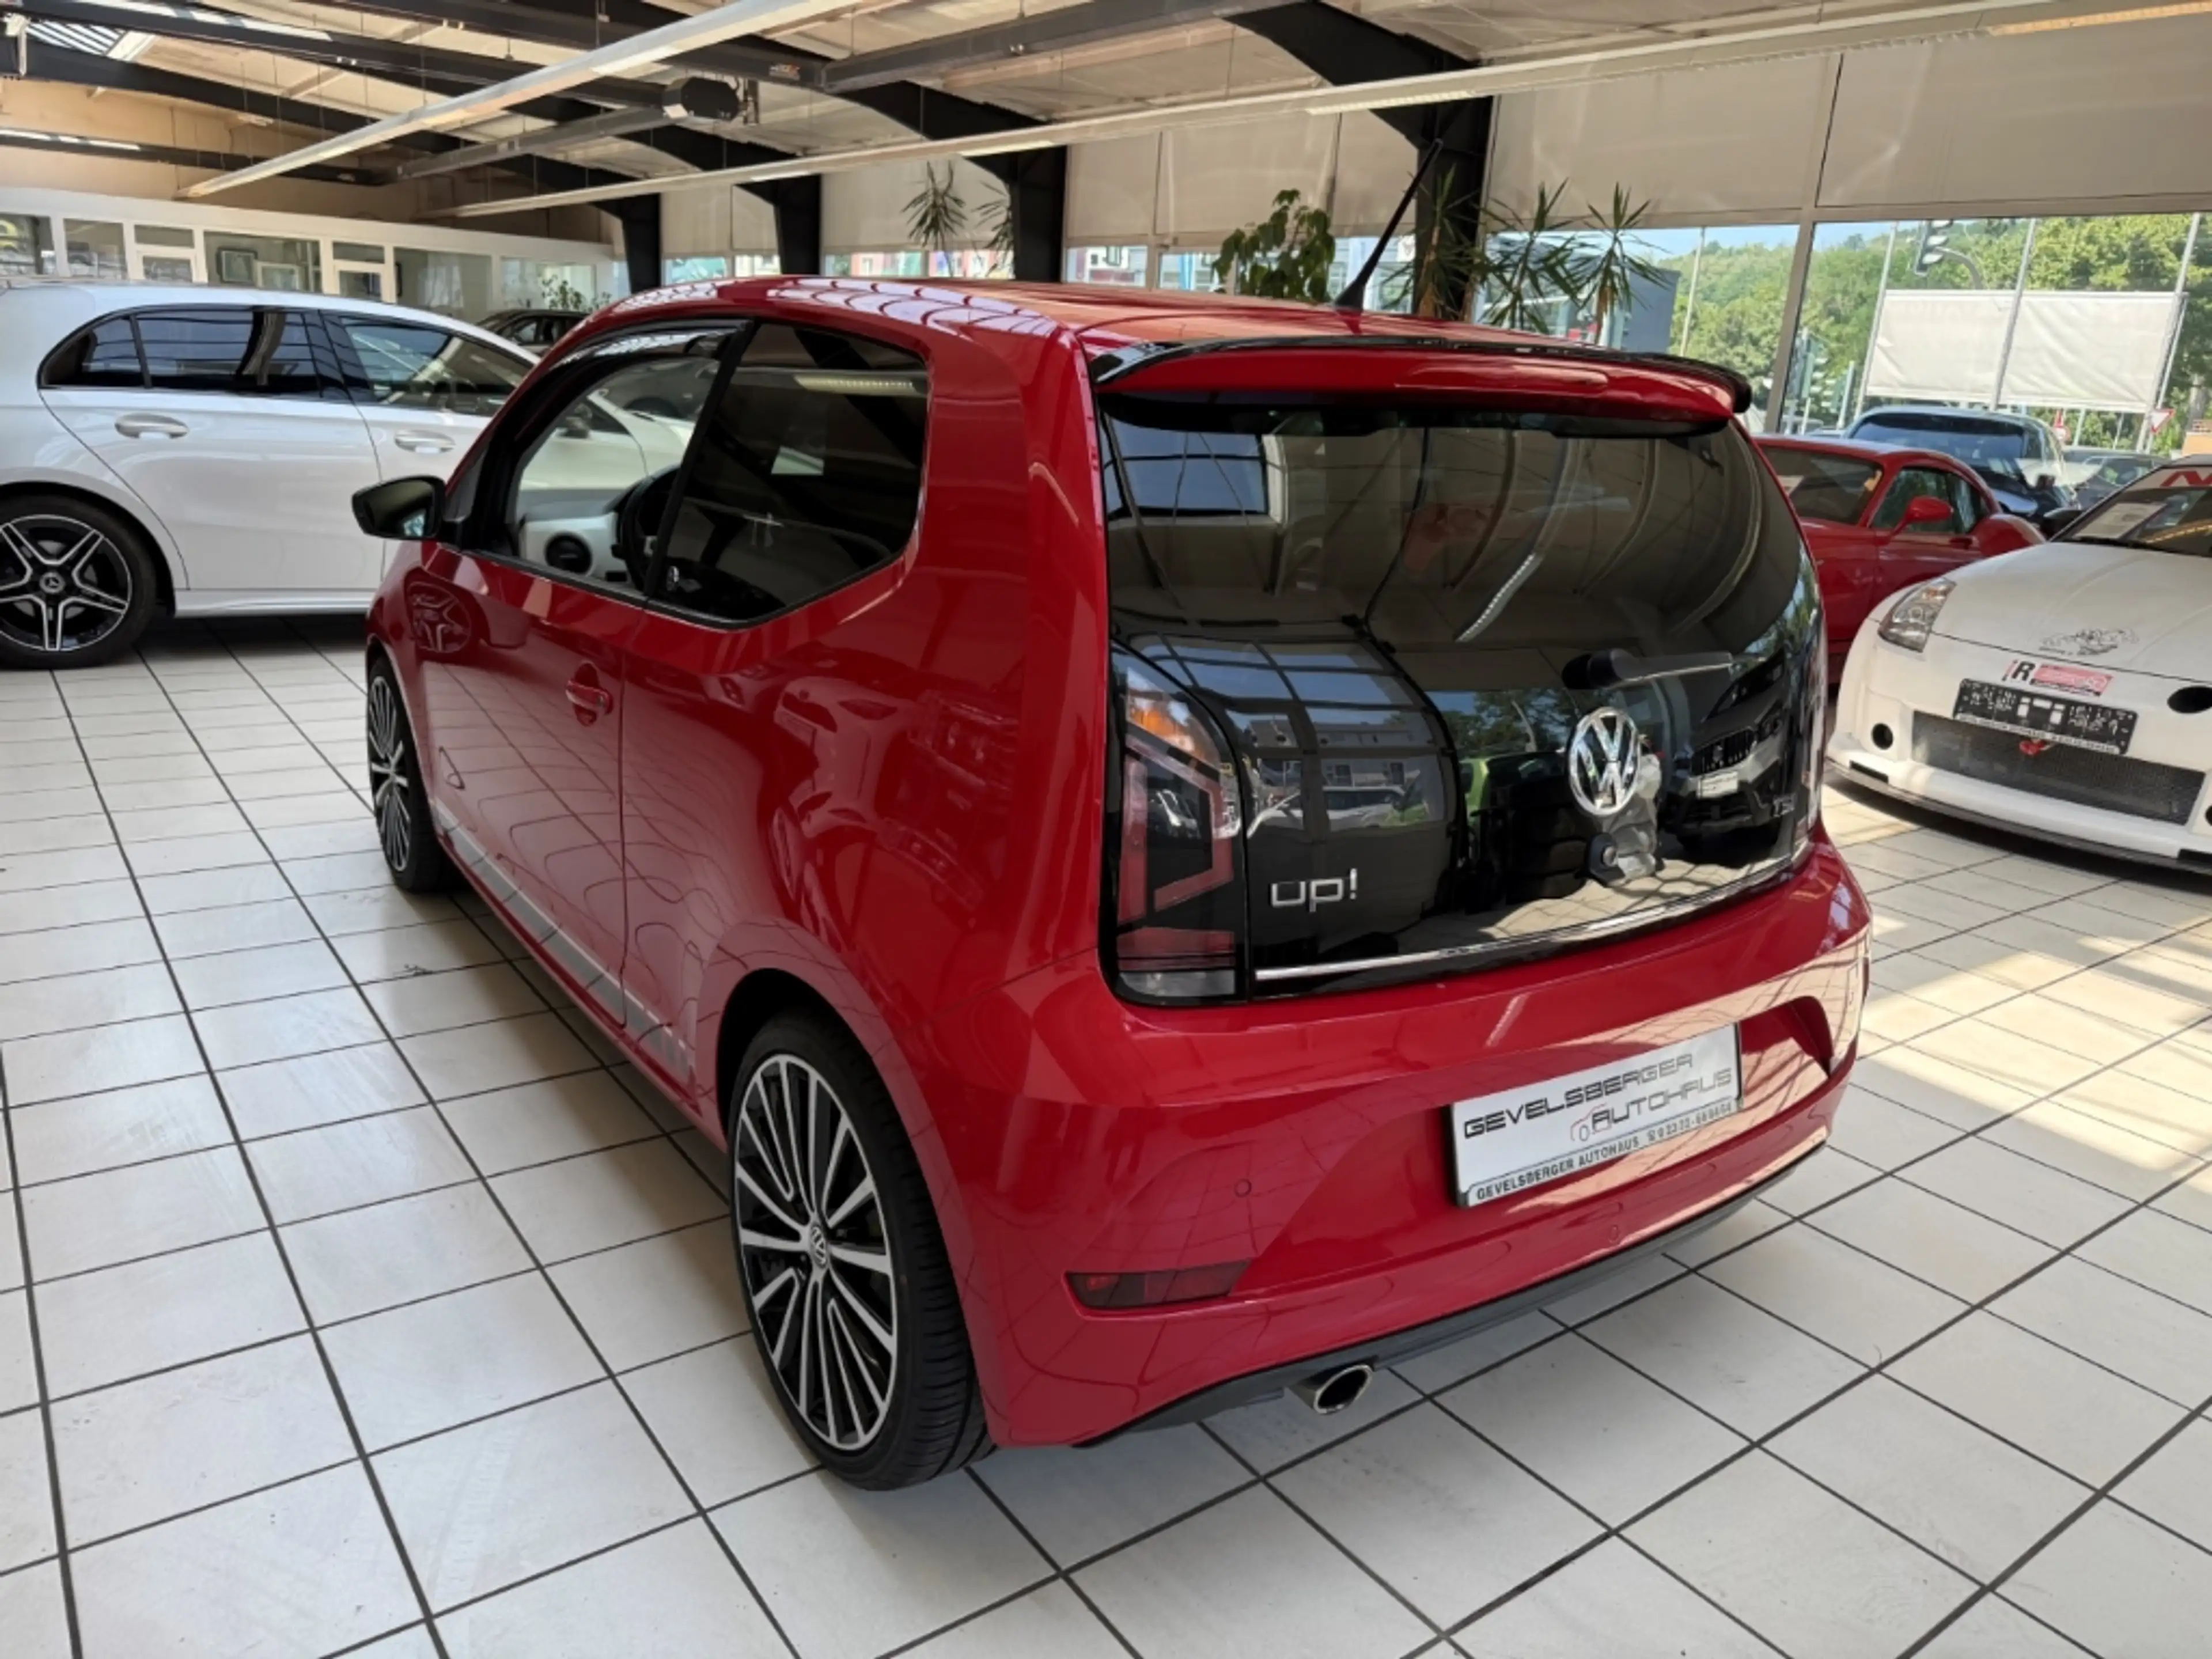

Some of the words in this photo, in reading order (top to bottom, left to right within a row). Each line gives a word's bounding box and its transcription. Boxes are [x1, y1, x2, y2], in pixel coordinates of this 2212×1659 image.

[1271, 868, 1358, 913] up!
[1463, 1054, 1692, 1139] GEVELSBERGER
[1591, 1068, 1733, 1125] AUTOHAUS
[1476, 1158, 1574, 1200] GEVELSBERGER
[1578, 1136, 1640, 1167] AUTOHAUS
